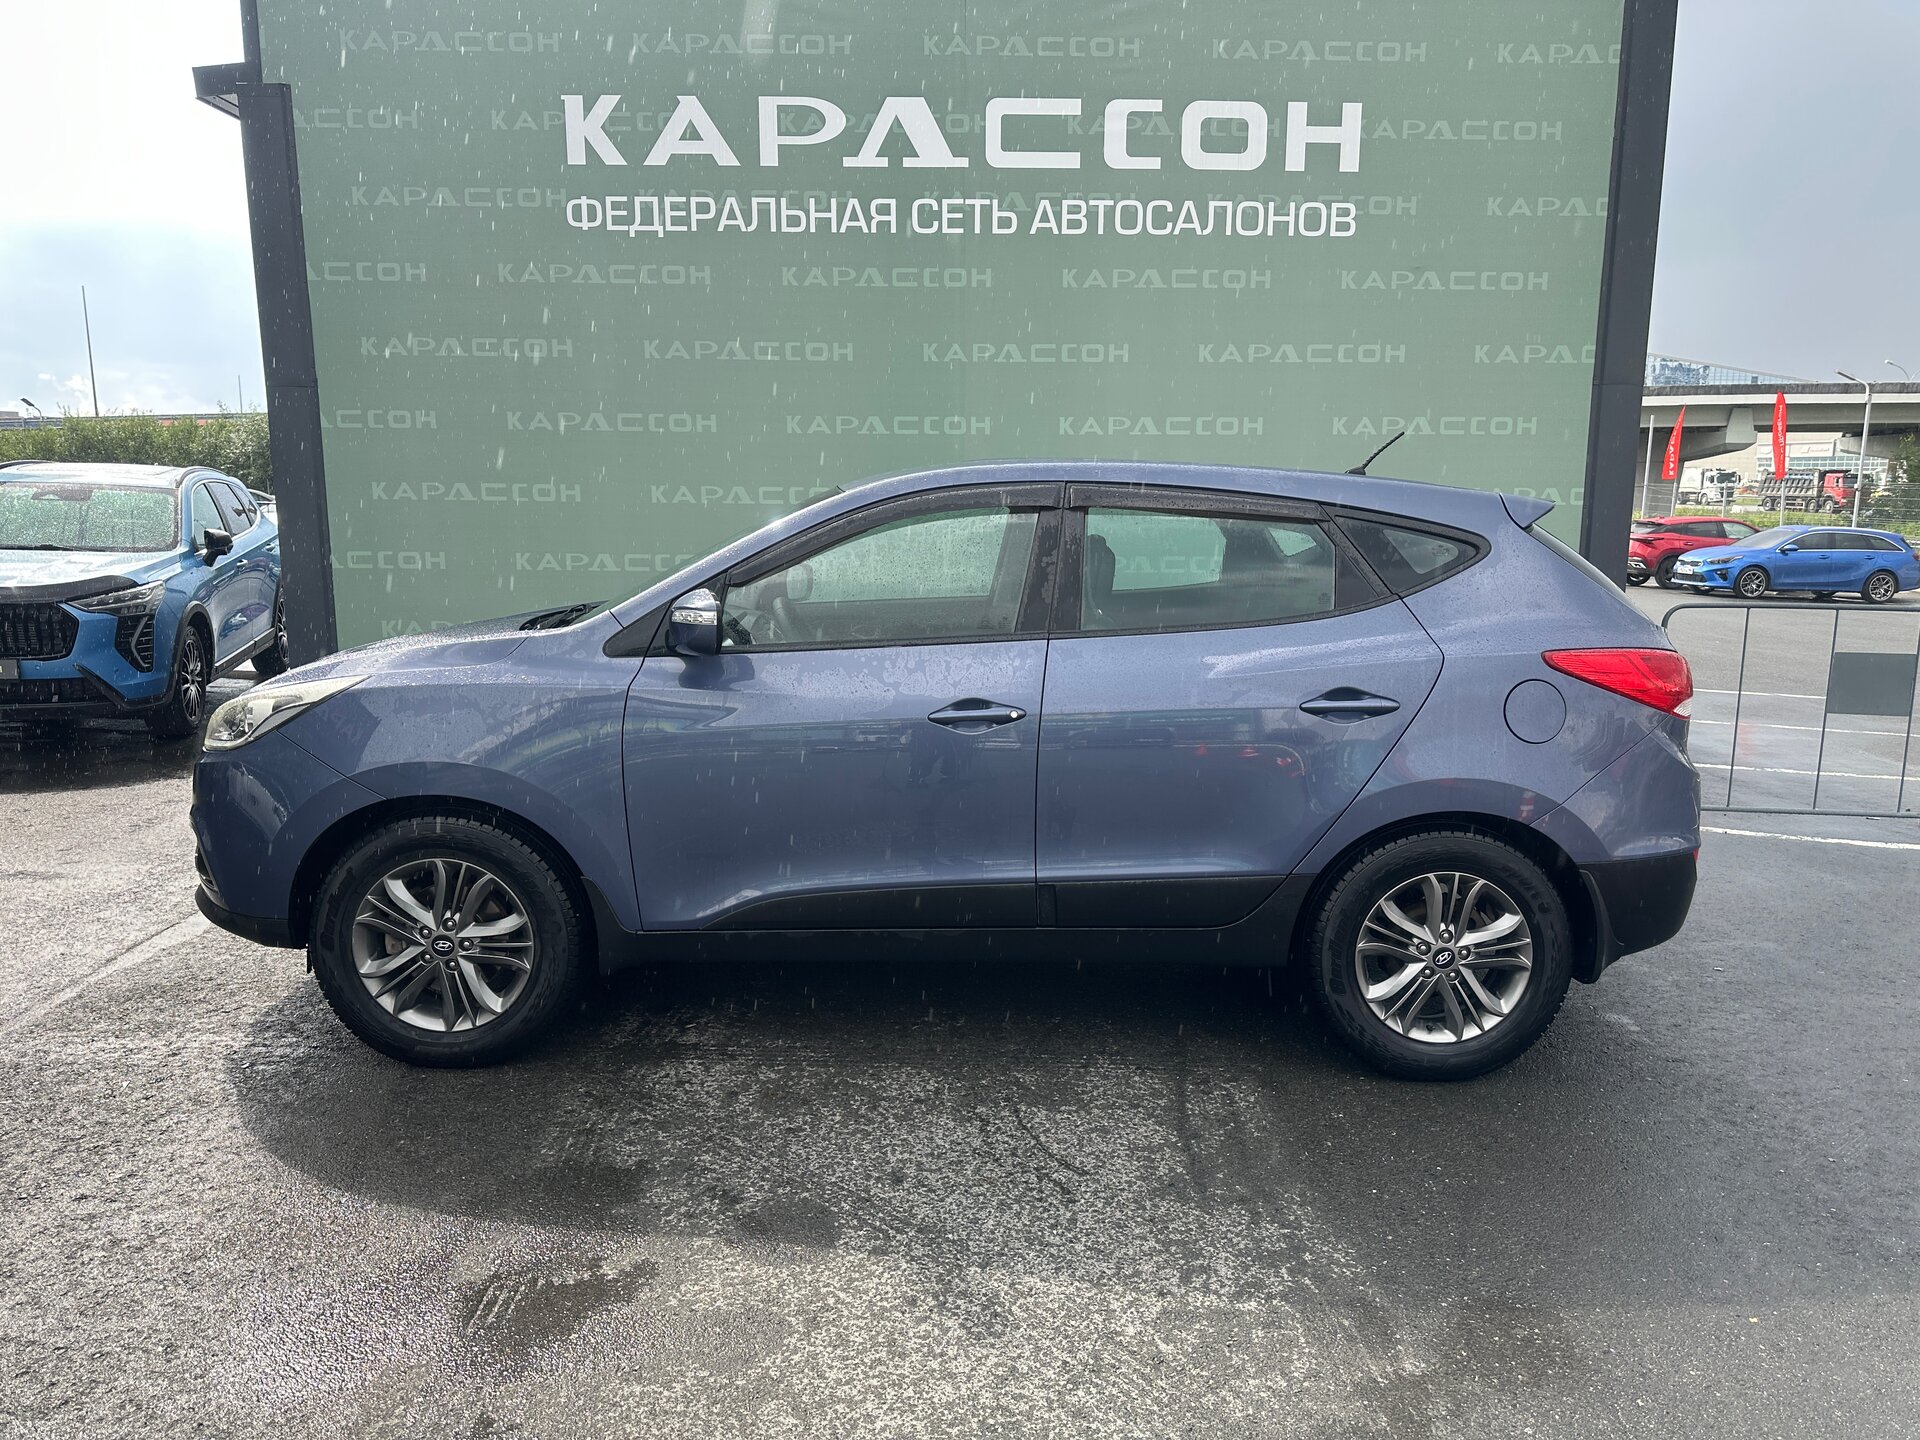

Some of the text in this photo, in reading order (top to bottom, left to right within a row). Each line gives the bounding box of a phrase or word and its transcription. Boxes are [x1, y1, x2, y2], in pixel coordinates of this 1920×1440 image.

[566, 195, 1357, 238] ФЕДЕРАЛЬНАЯ СЕТЬ АВТОСАЛОНОВ
